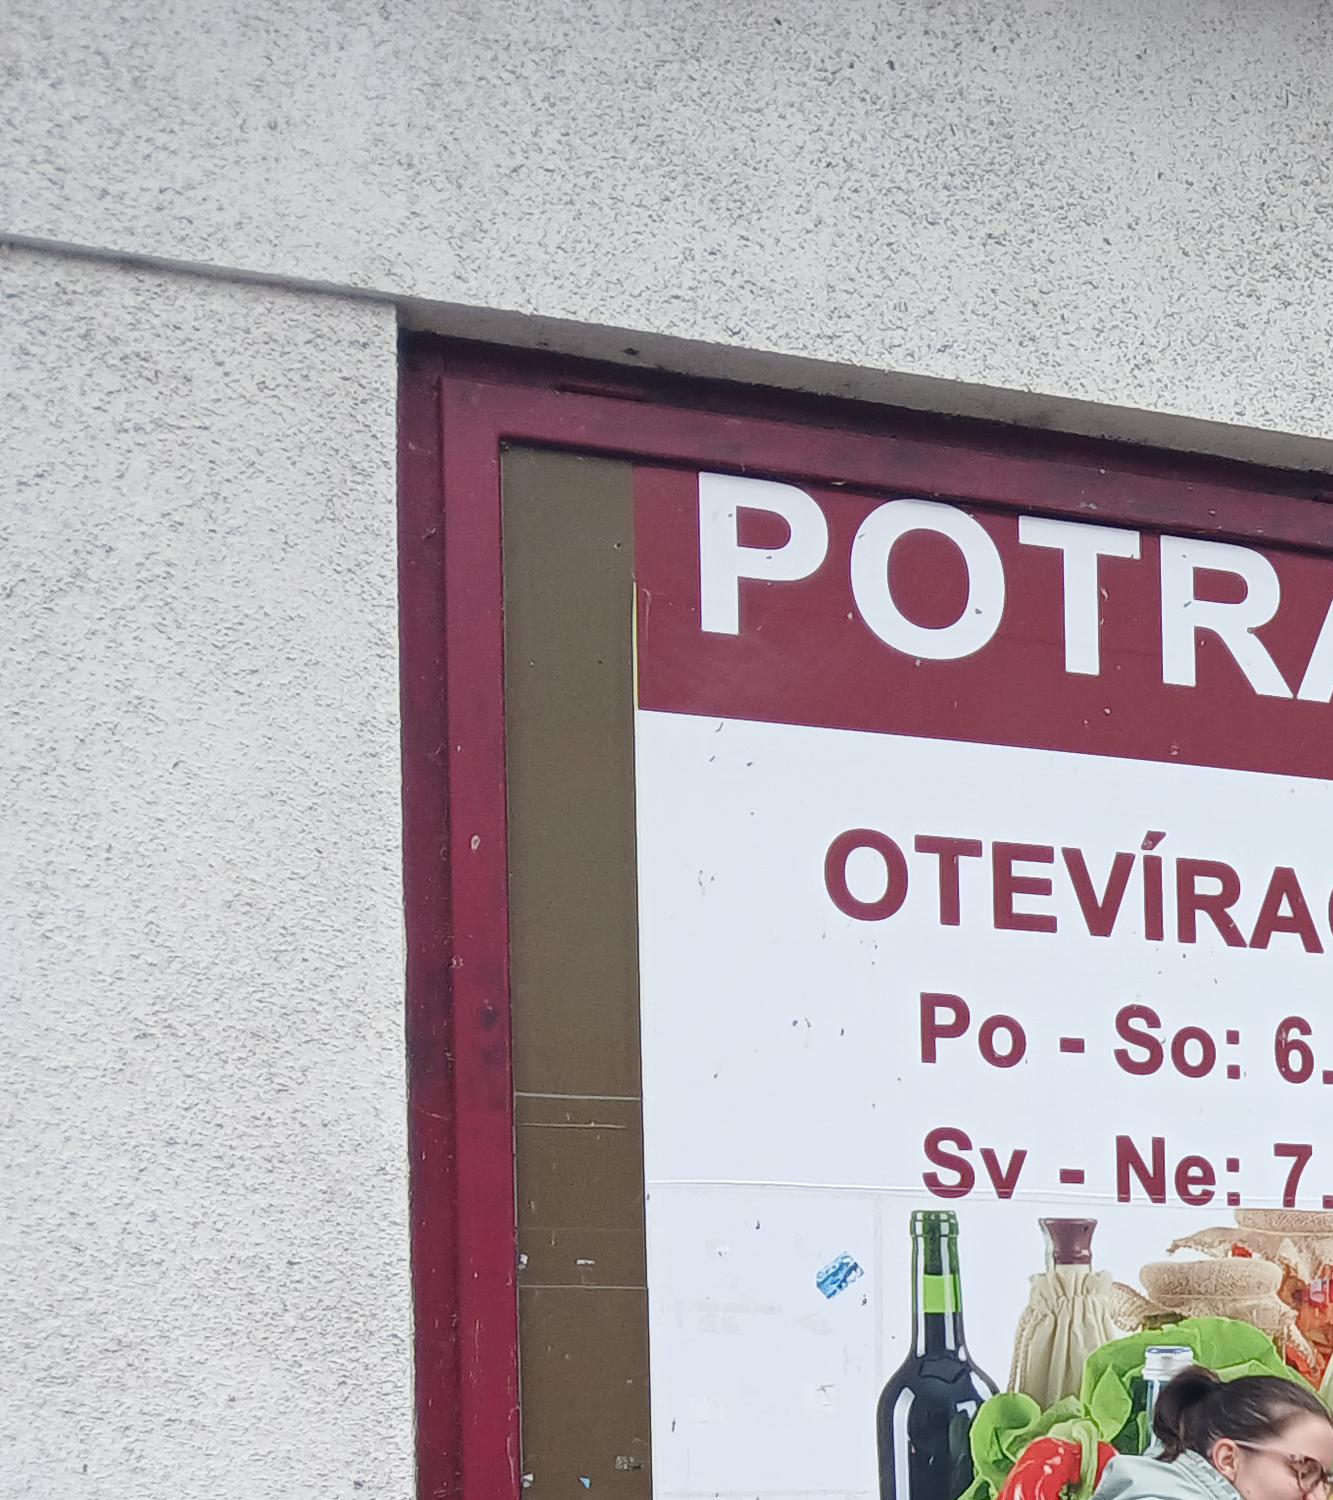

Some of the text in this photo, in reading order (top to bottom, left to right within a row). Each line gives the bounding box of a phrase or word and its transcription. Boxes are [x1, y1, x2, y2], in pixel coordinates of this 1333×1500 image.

[919, 991, 1027, 1068] Po
[1059, 1036, 1085, 1054] -
[1113, 1003, 1241, 1080] So:
[922, 1127, 1028, 1199] Sv
[1059, 1168, 1085, 1185] -
[1115, 1134, 1241, 1207] Ne:
